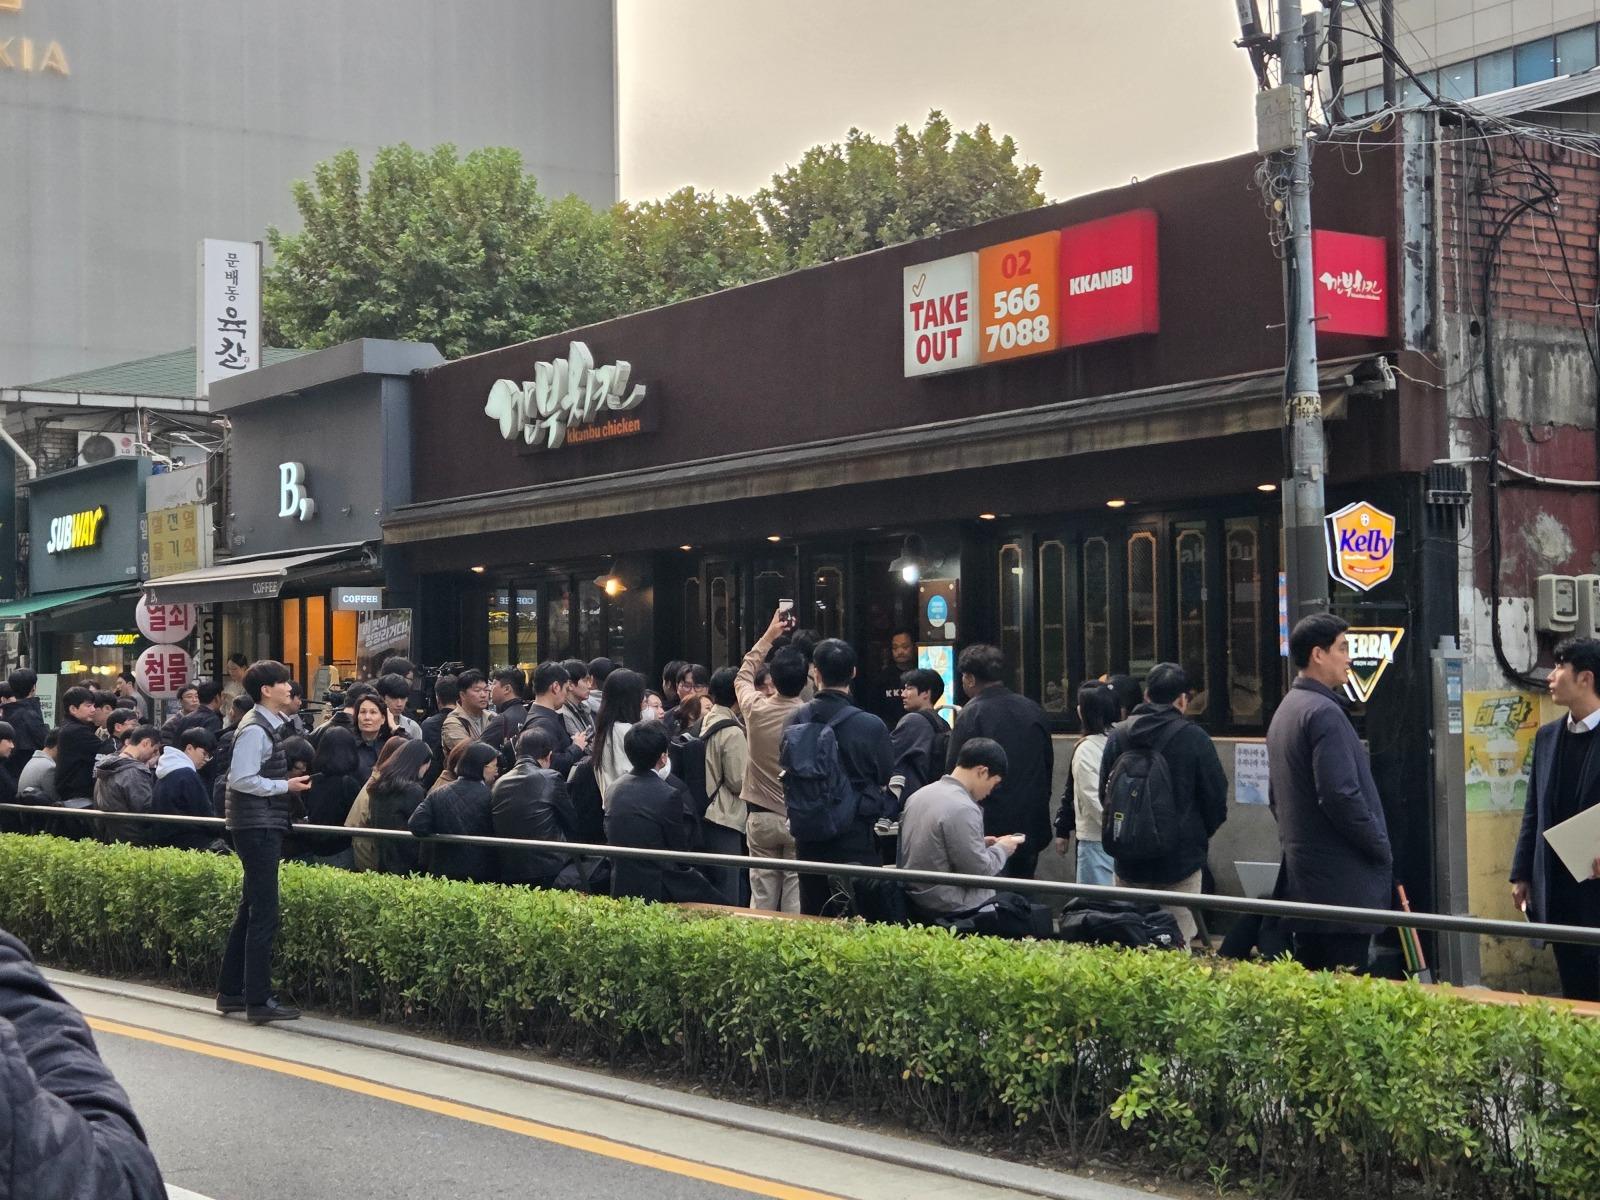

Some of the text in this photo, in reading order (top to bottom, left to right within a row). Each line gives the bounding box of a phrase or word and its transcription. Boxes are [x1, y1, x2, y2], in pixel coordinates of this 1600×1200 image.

[225, 253, 240, 302] 문배동
[1001, 250, 1031, 279] 02
[1069, 265, 1133, 296] KKANBU
[1319, 269, 1382, 297] 깐부치킨
[909, 291, 968, 331] TAKE
[993, 283, 1040, 319] 566
[215, 306, 247, 370] 육칼
[916, 328, 962, 364] OUT
[985, 315, 1050, 353] 7088
[484, 340, 647, 449] 깐부치킨
[566, 418, 641, 445] kkanbu chicken
[47, 506, 103, 554] SUBWAY
[1339, 528, 1393, 560] Kelly
[252, 581, 278, 594] COFFEE
[342, 594, 378, 603] COFFEE
[146, 604, 188, 631] 열쇠
[94, 634, 139, 645] SUBWAY
[145, 653, 188, 692] 철물
